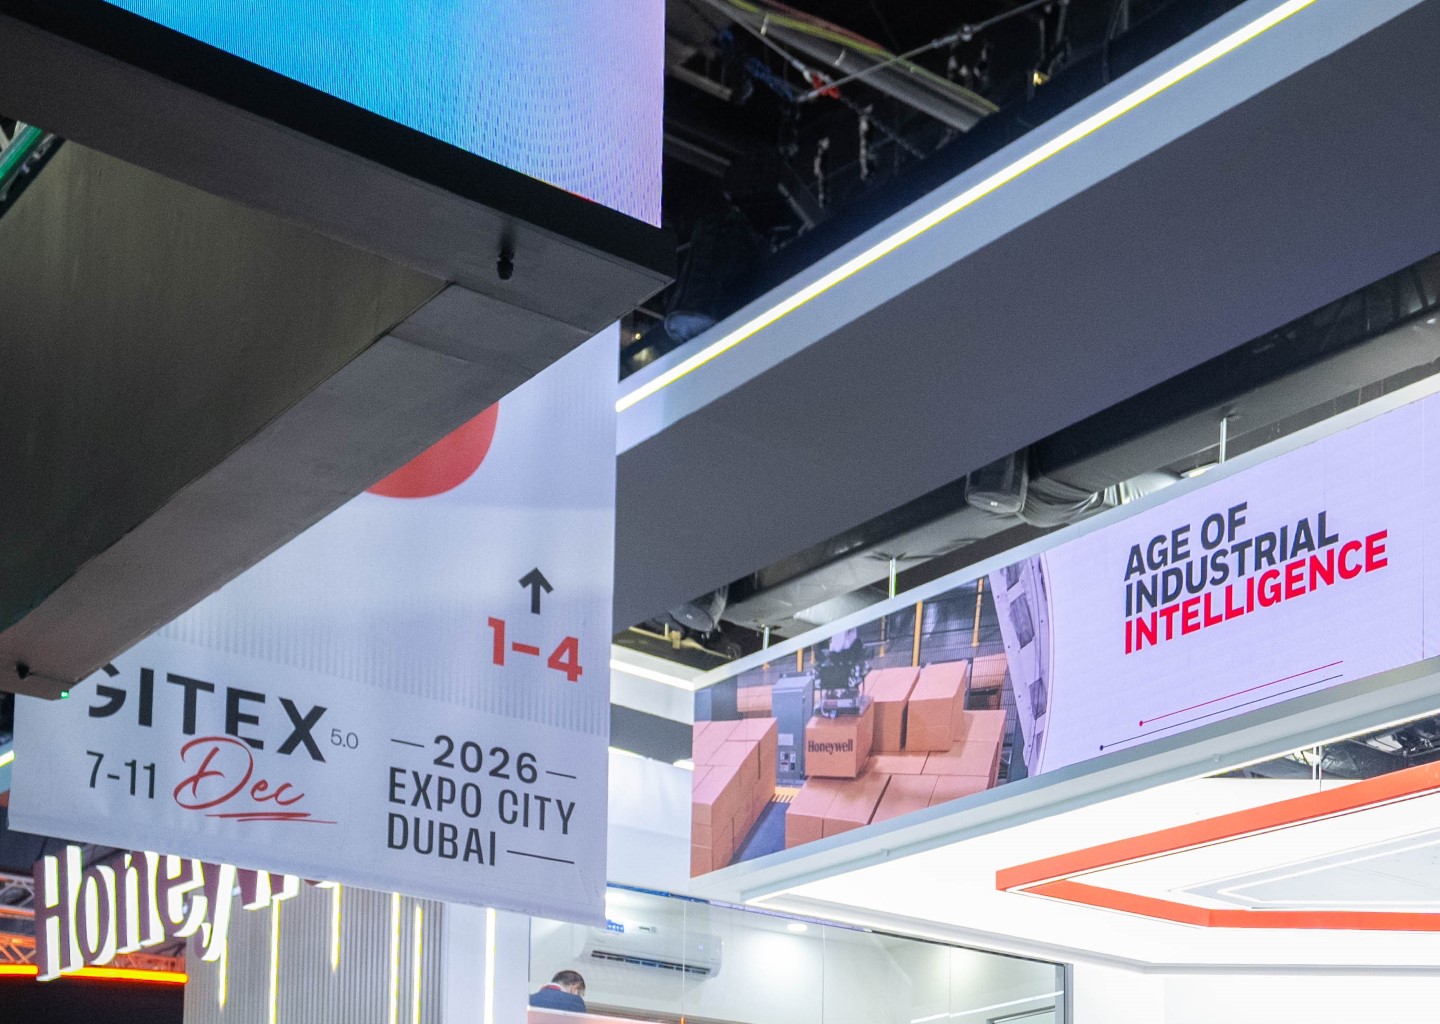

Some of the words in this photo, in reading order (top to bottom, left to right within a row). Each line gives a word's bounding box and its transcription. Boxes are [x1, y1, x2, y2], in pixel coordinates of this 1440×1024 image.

[1126, 524, 1191, 580] AGE
[1202, 502, 1248, 550] OF
[1126, 512, 1339, 617] INDUSTRIAL
[1125, 529, 1388, 655] INTELLIGENCE
[87, 750, 156, 799] 7-11
[173, 736, 305, 810] Dec
[330, 728, 359, 749] 5.0
[433, 735, 538, 784] 2026
[808, 739, 853, 755] Honeywell
[388, 766, 482, 818] EXPO
[498, 789, 576, 835] CITY
[387, 812, 496, 866] DUBAI
